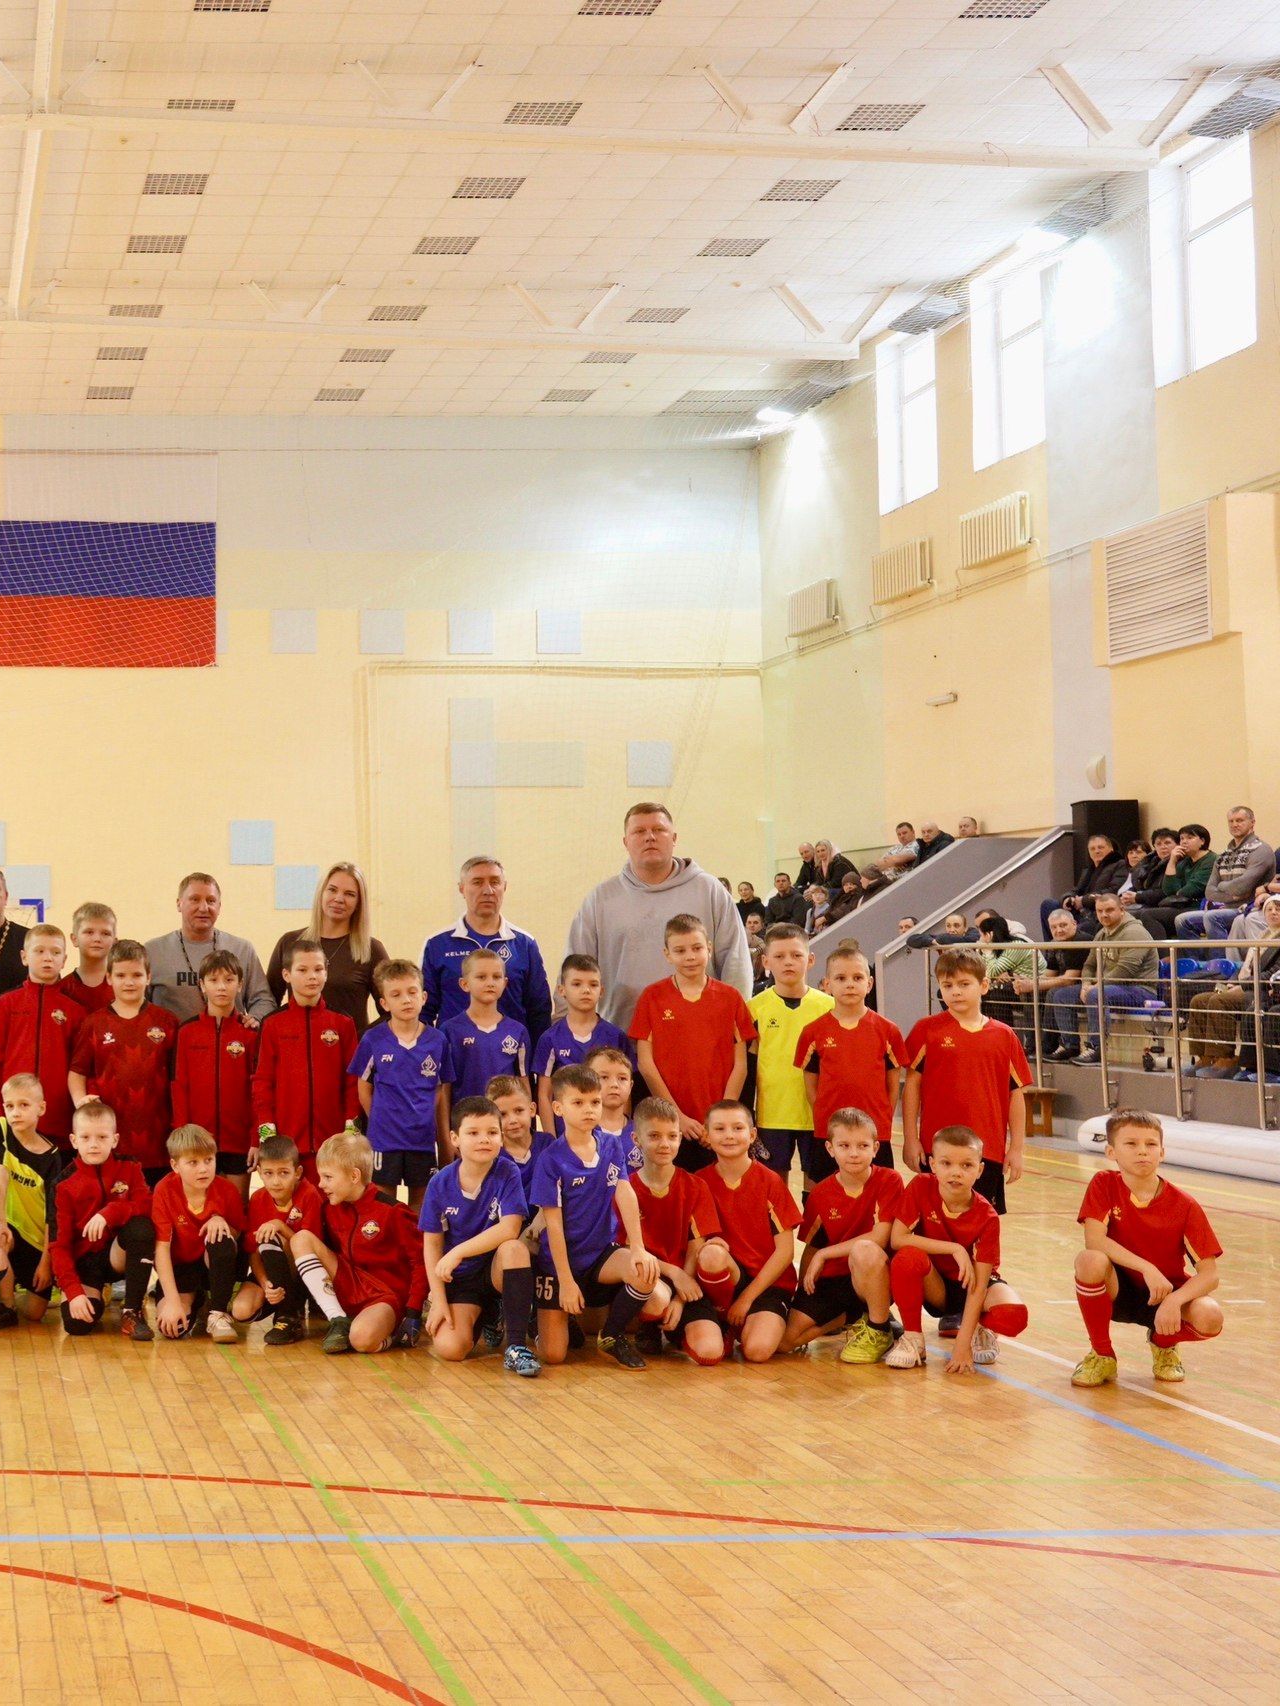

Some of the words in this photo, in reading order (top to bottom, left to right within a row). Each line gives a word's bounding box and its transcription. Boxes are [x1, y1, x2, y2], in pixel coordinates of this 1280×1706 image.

[176, 971, 198, 986] PU
[10, 1170, 37, 1188] ИУМФ
[535, 1276, 554, 1301] 55
